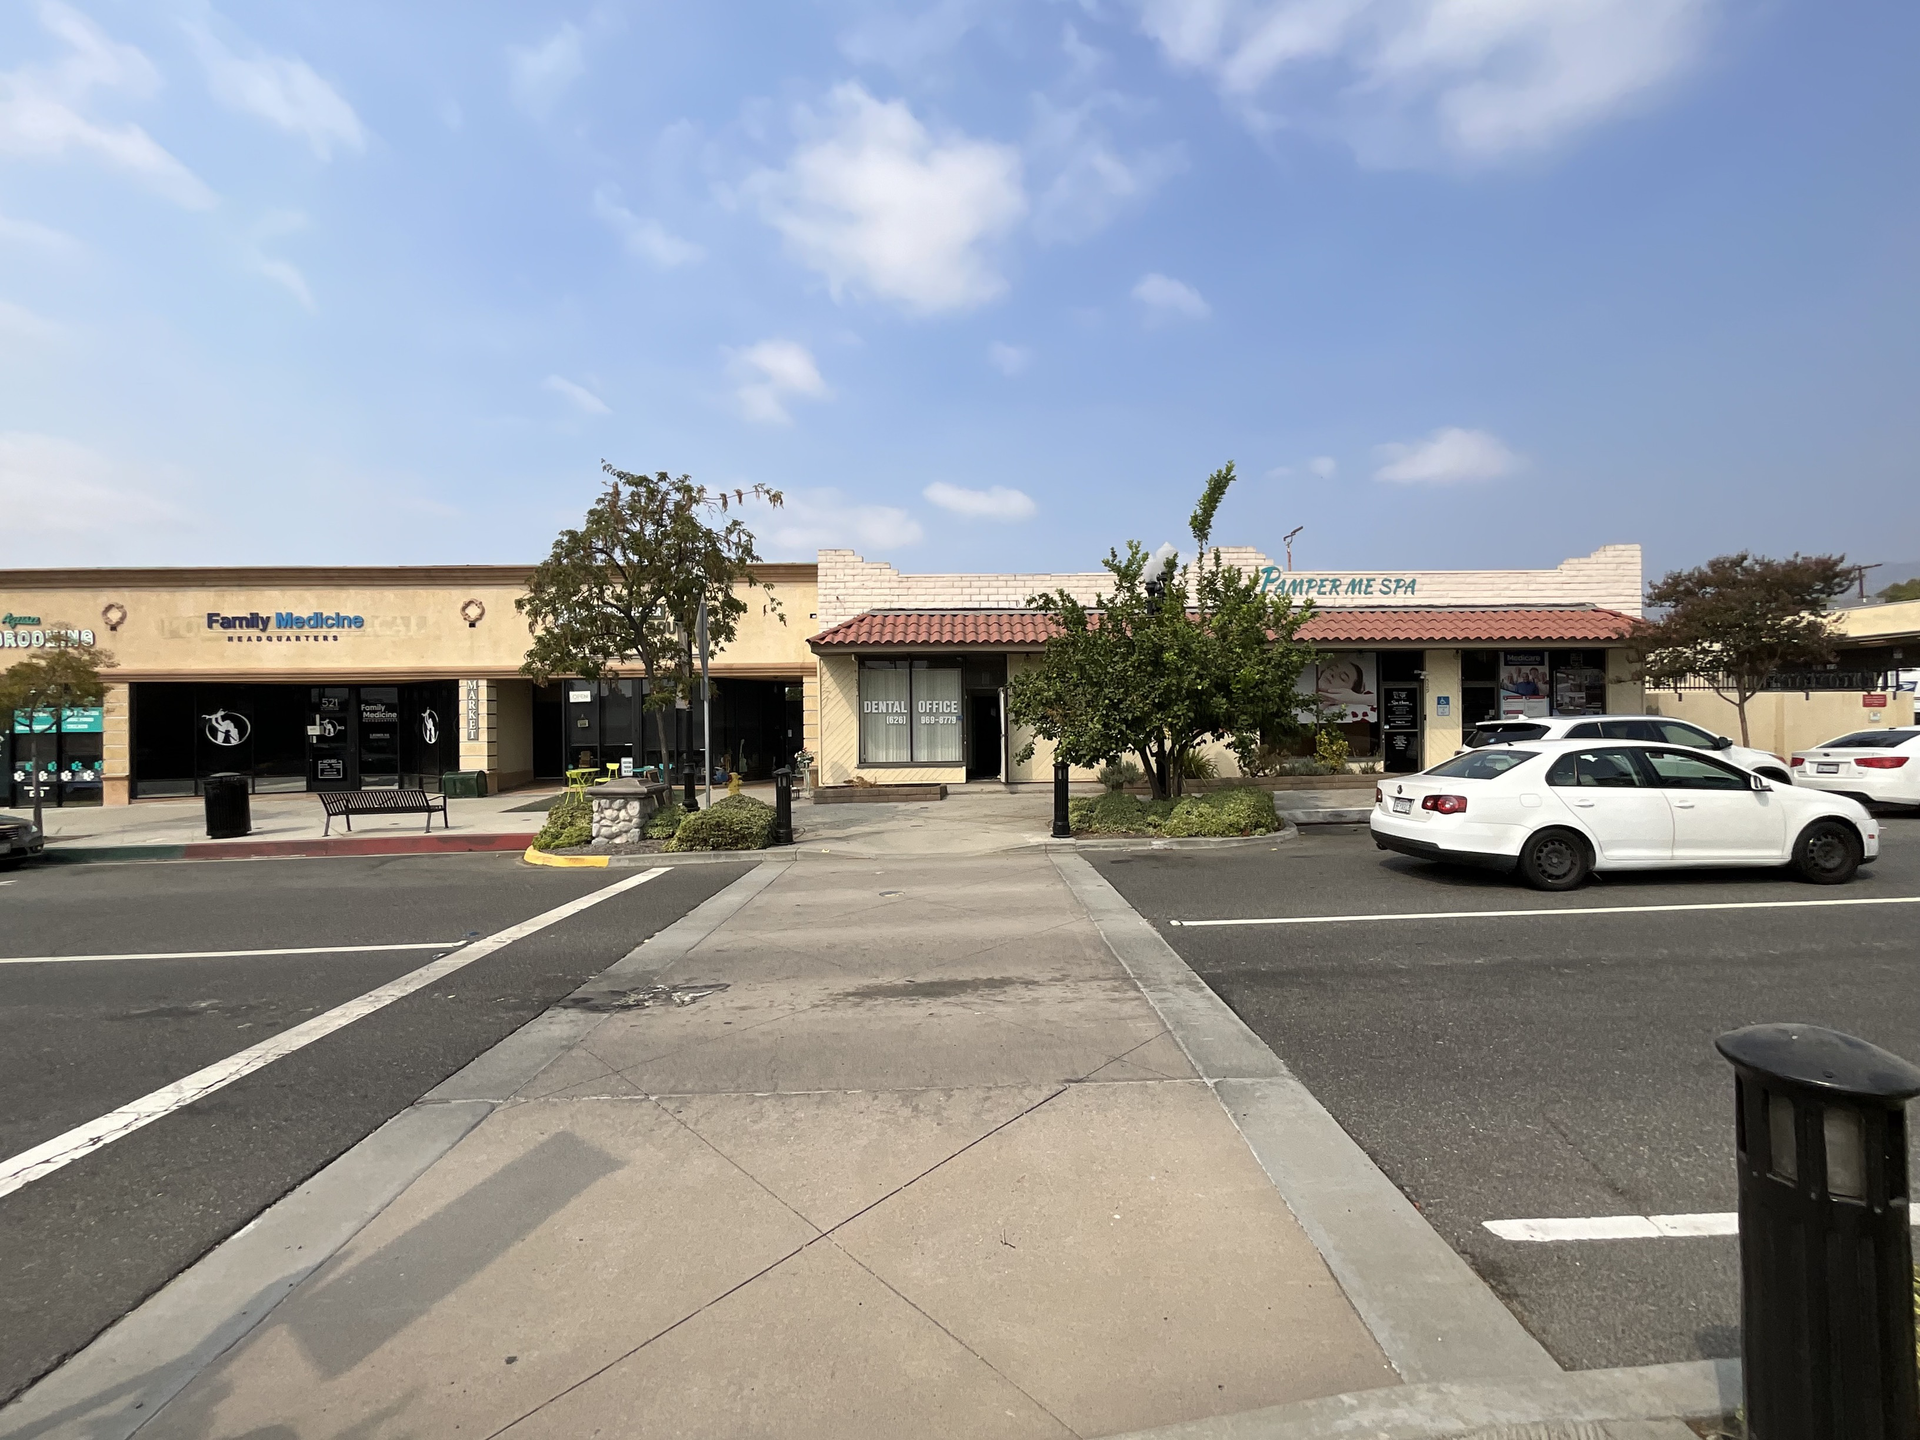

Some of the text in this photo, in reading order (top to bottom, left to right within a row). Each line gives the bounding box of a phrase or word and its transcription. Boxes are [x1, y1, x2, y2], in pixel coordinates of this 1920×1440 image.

[1260, 566, 1417, 596] PAMPER ME SPA
[206, 612, 270, 632] Family
[275, 612, 364, 629] Medicine
[0, 629, 95, 648] ROOMING
[1507, 654, 1541, 662] Medicare
[322, 698, 338, 707] 521
[361, 703, 385, 712] Family
[864, 701, 958, 713] DENTAL OFFICE
[467, 680, 478, 739] MARKET
[886, 715, 956, 724] (626) 969-8779
